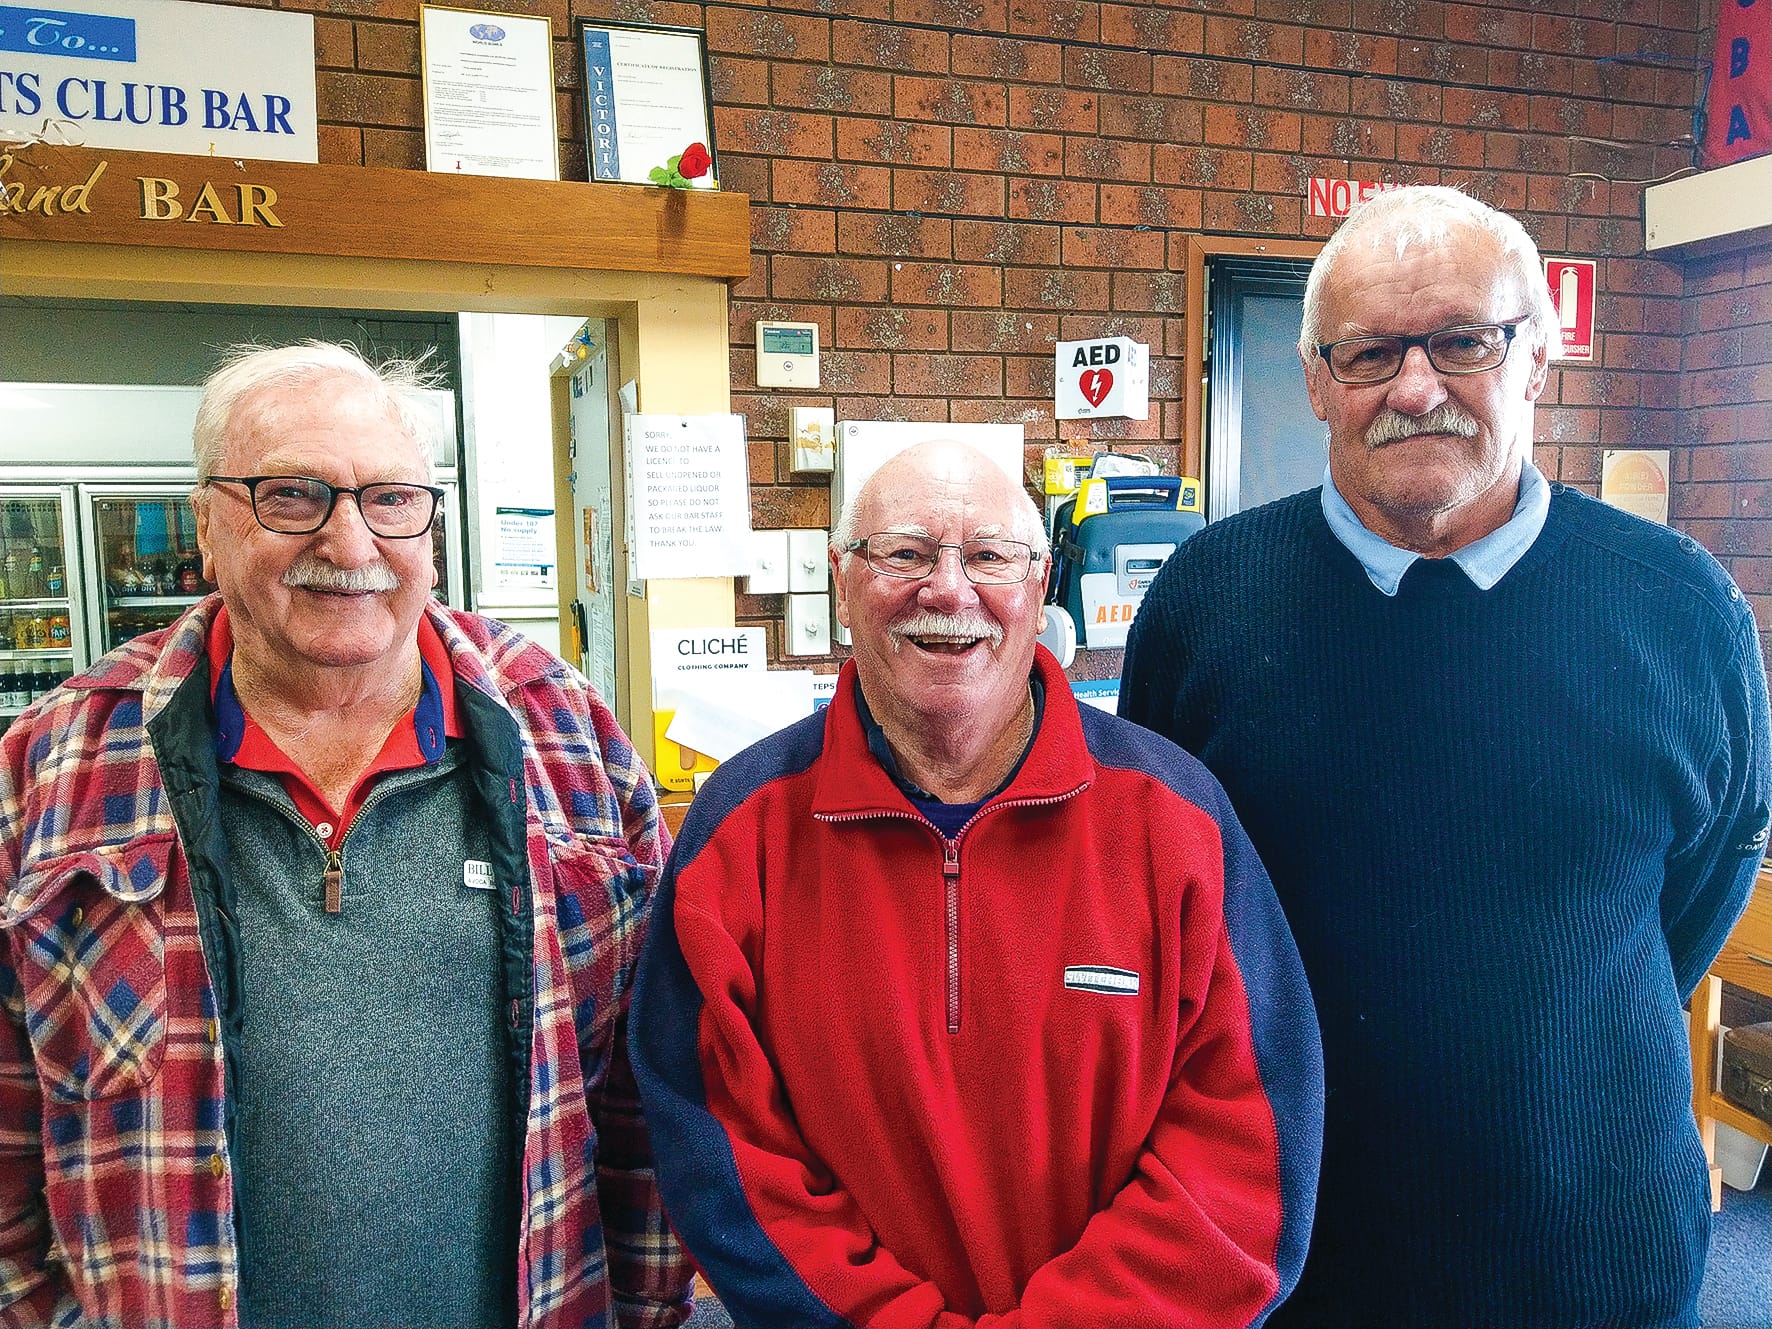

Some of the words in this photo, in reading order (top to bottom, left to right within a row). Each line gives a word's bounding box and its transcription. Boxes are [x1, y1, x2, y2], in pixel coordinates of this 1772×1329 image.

[25, 17, 120, 54] To...
[1726, 0, 1752, 147] BA
[57, 77, 188, 126] CLUB
[201, 89, 296, 136] BAR
[593, 66, 613, 178] VICTORIA
[1309, 177, 1350, 217] NO
[136, 176, 286, 229] BAR
[1563, 344, 1590, 354] GUISHER
[1072, 344, 1121, 368] AED
[645, 445, 659, 453] WE
[660, 445, 673, 453] DO
[692, 445, 713, 453] HAVE
[714, 445, 721, 453] A
[646, 457, 675, 465] LICENC
[646, 471, 663, 479] SELL
[665, 471, 709, 479] UNOPENED
[690, 484, 720, 493] LIQUOR
[647, 498, 659, 507] SO
[660, 498, 687, 507] PLEASE
[689, 498, 702, 506] DO
[703, 498, 719, 506] NOT
[648, 512, 664, 521] ASK
[665, 512, 682, 520] OUR
[683, 512, 700, 520] BAR
[700, 511, 723, 519] STAFF
[649, 526, 660, 534] TO
[662, 526, 687, 534] BREAK
[689, 525, 703, 533] THE
[650, 540, 677, 548] THANK
[1096, 604, 1133, 624] AED
[677, 633, 748, 656] CLICHÉ
[1073, 689, 1098, 699] Health
